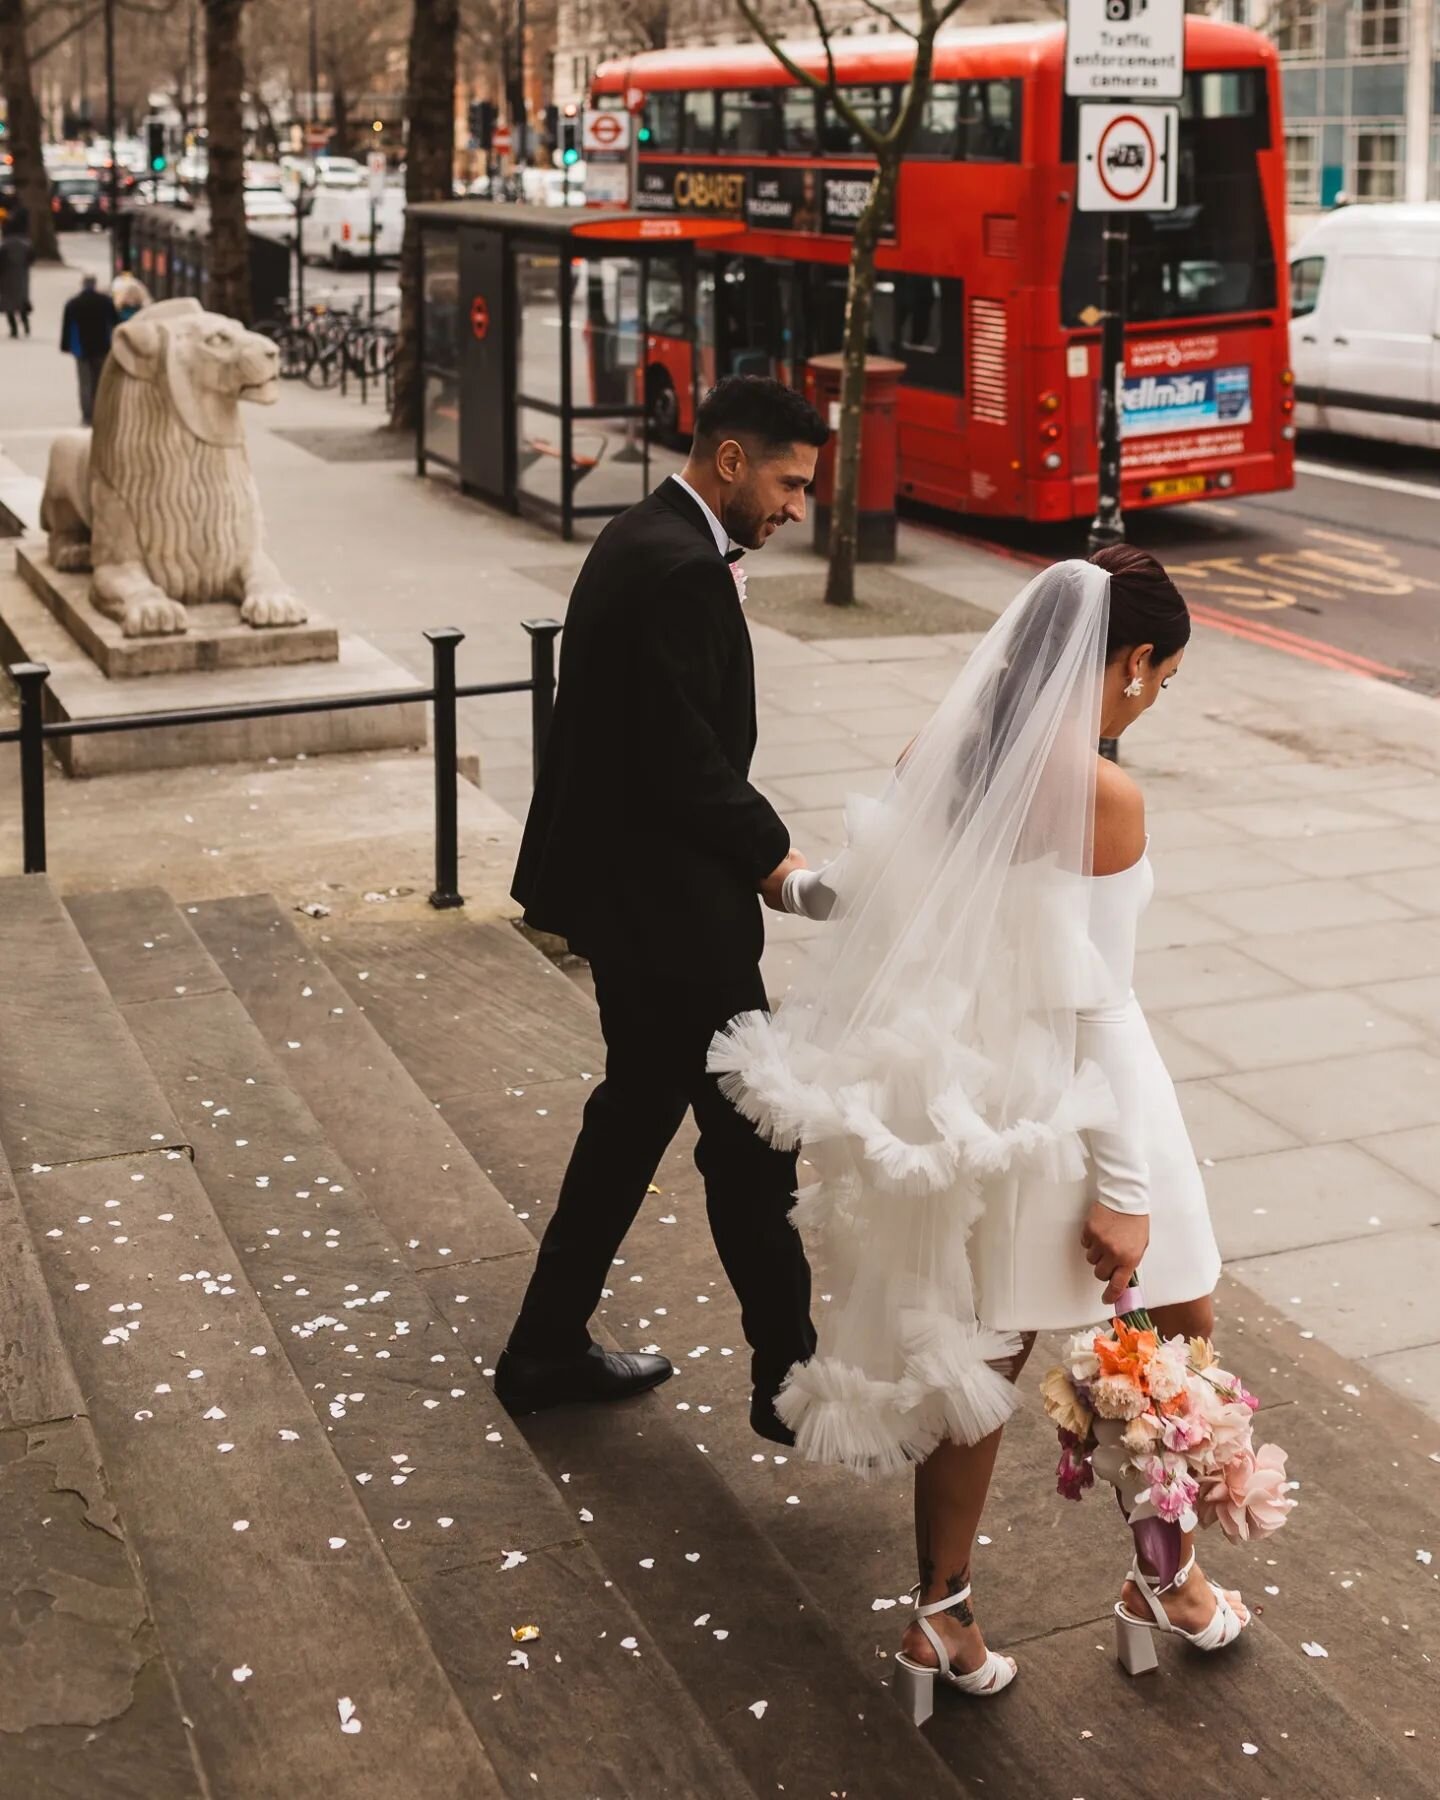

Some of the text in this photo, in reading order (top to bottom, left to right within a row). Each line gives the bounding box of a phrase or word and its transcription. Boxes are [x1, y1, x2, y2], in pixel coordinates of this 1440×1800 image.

[1099, 31, 1151, 48] Traffic
[1073, 52, 1175, 68] enforcement
[1089, 76, 1159, 89] cameras
[674, 170, 746, 209] CABARET
[1121, 376, 1207, 411] ellman
